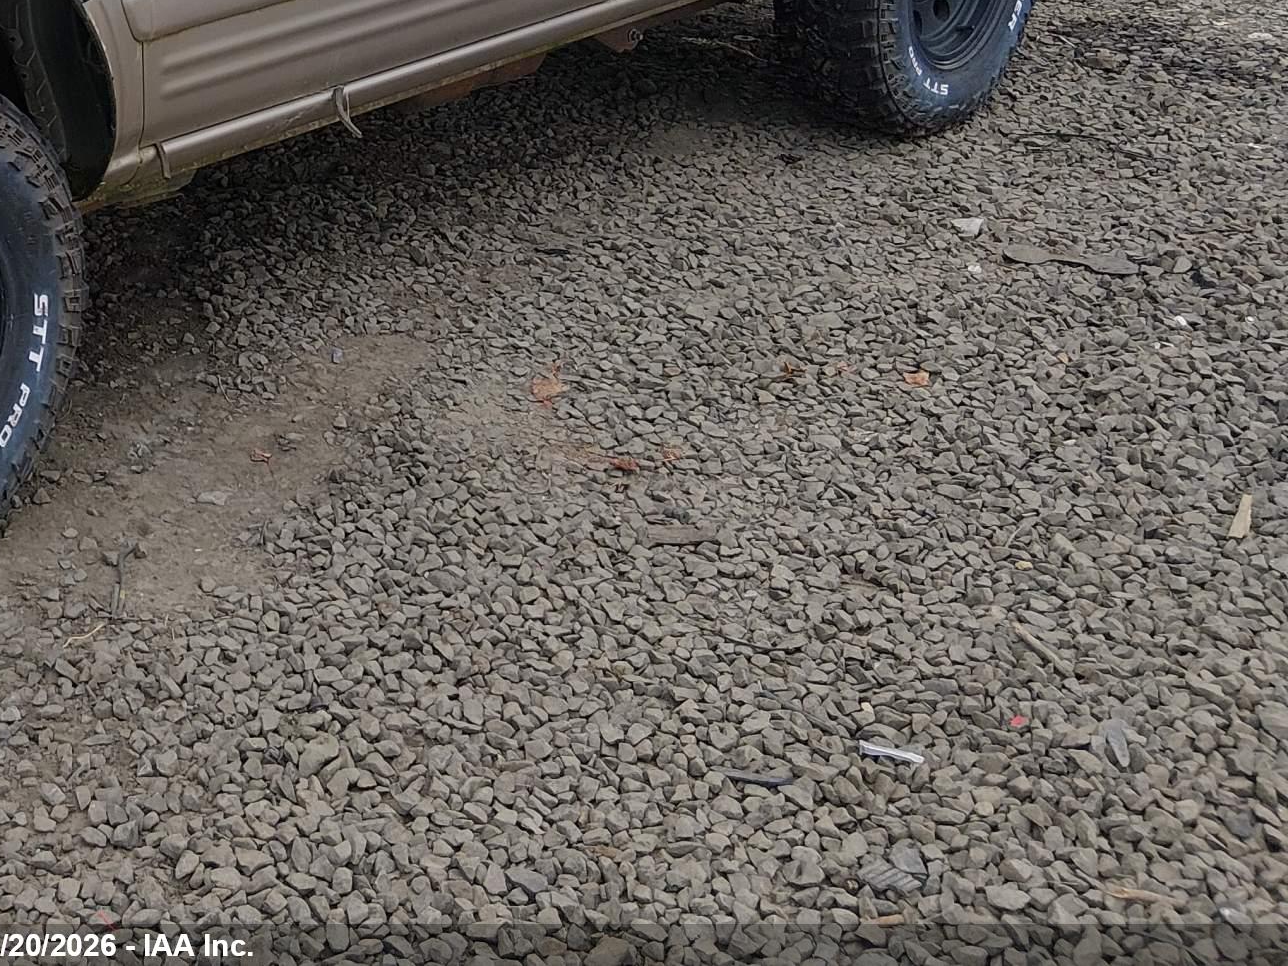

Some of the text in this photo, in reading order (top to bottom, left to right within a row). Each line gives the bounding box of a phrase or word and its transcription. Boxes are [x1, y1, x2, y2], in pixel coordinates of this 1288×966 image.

[907, 45, 949, 96] STT PRO
[29, 292, 50, 373] STT
